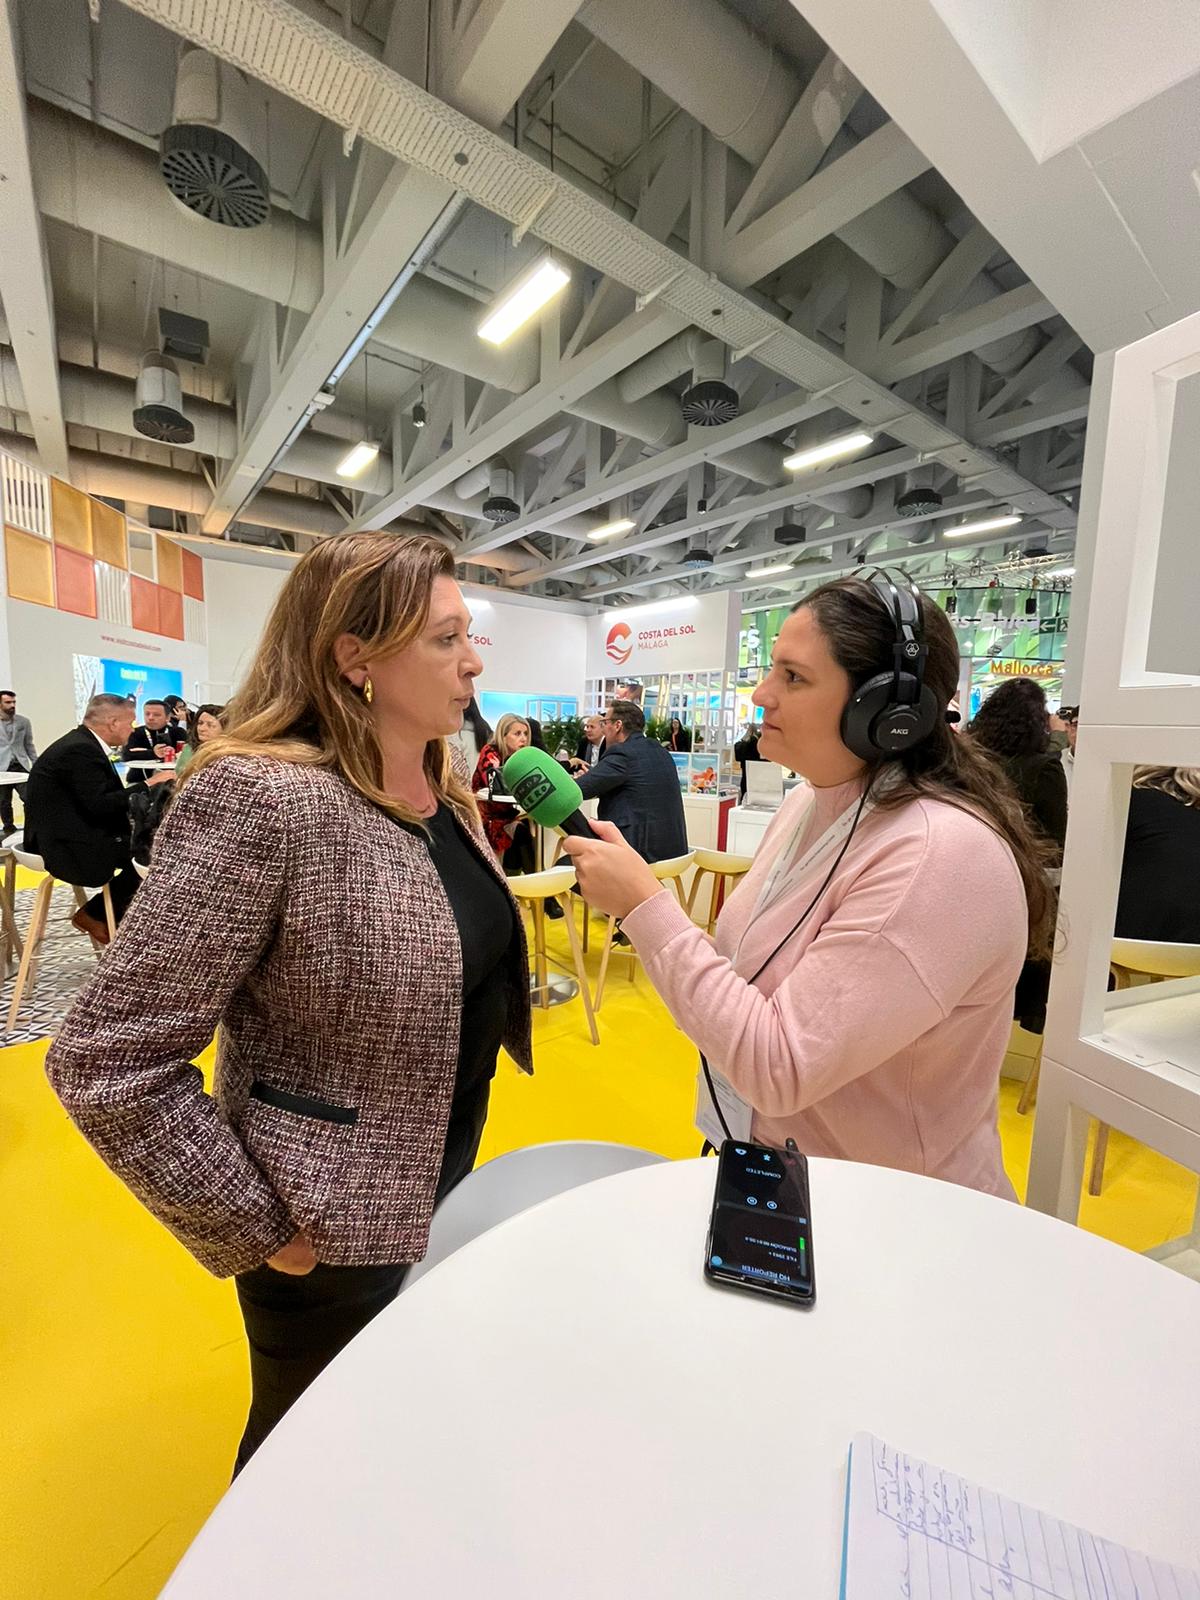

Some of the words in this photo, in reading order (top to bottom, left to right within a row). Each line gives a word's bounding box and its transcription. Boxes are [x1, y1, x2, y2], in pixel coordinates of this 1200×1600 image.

[638, 630, 662, 640] COSTA
[663, 627, 678, 637] DEL
[679, 624, 696, 635] SOL
[473, 636, 493, 646] SOL
[990, 660, 1054, 677] Mallorca
